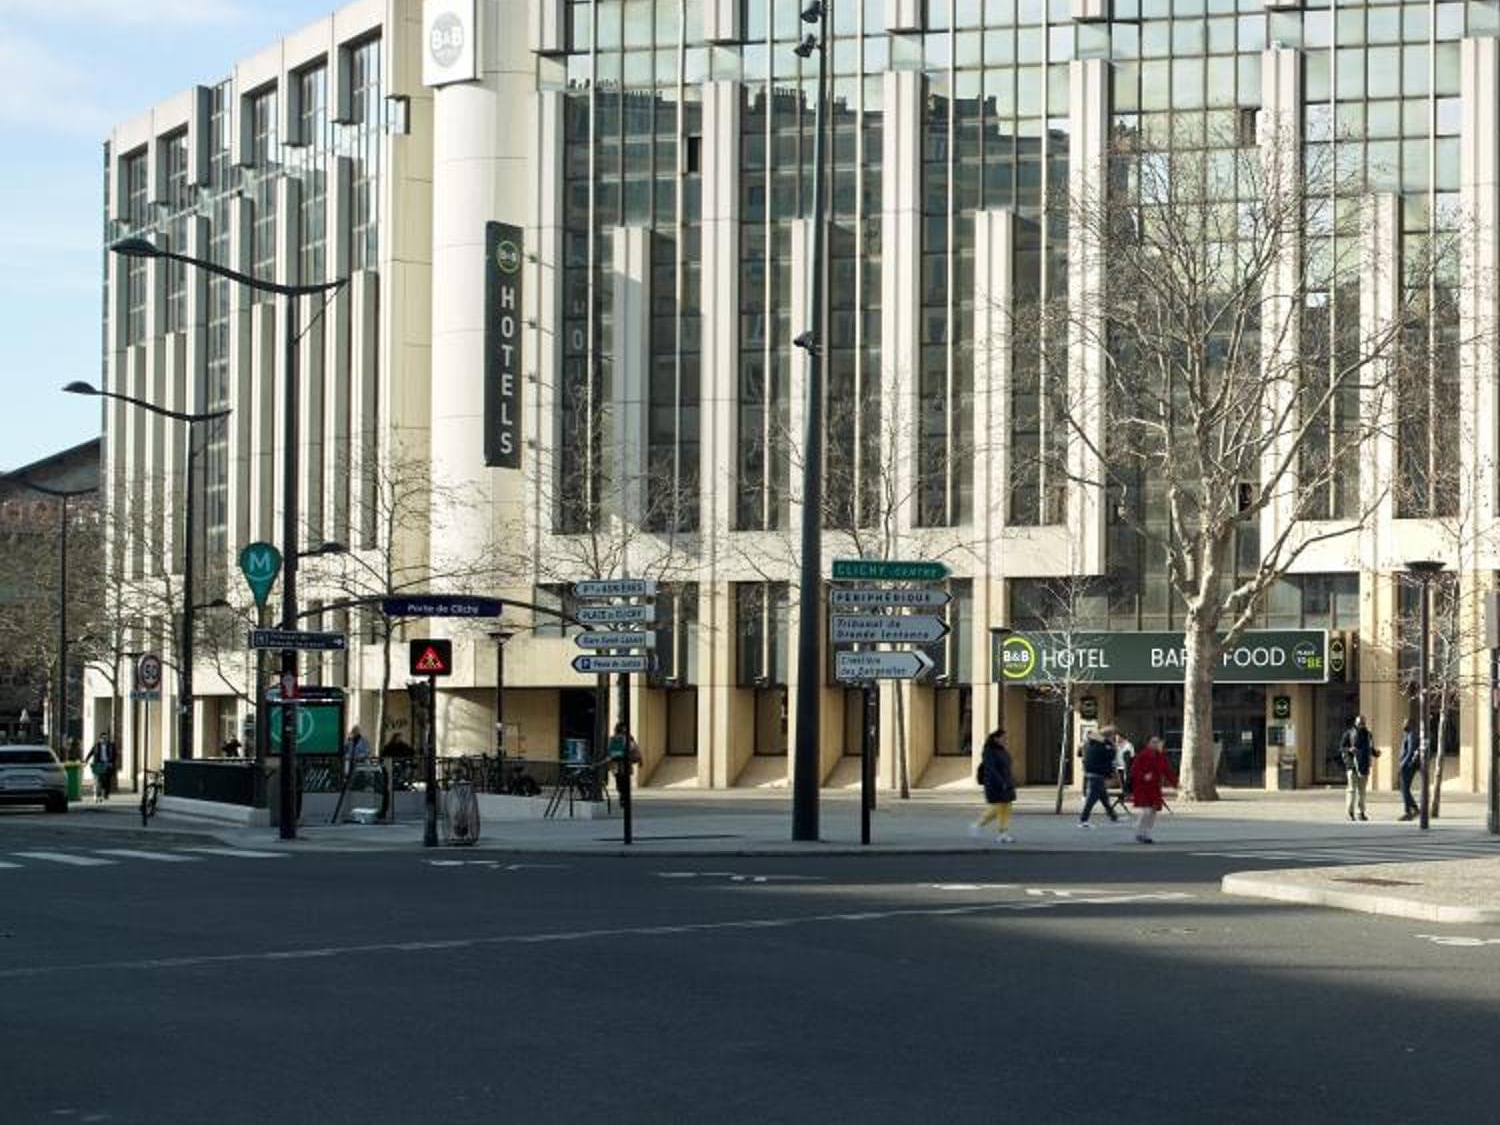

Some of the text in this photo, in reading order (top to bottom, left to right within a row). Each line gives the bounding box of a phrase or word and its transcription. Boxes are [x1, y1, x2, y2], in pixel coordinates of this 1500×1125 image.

[500, 286, 515, 454] HOTELS
[837, 563, 885, 575] CLICHY
[1003, 650, 1028, 662] B&B
[1042, 648, 1109, 668] HOTEL
[1223, 647, 1285, 667] FOOD
[1307, 656, 1322, 668] BE
